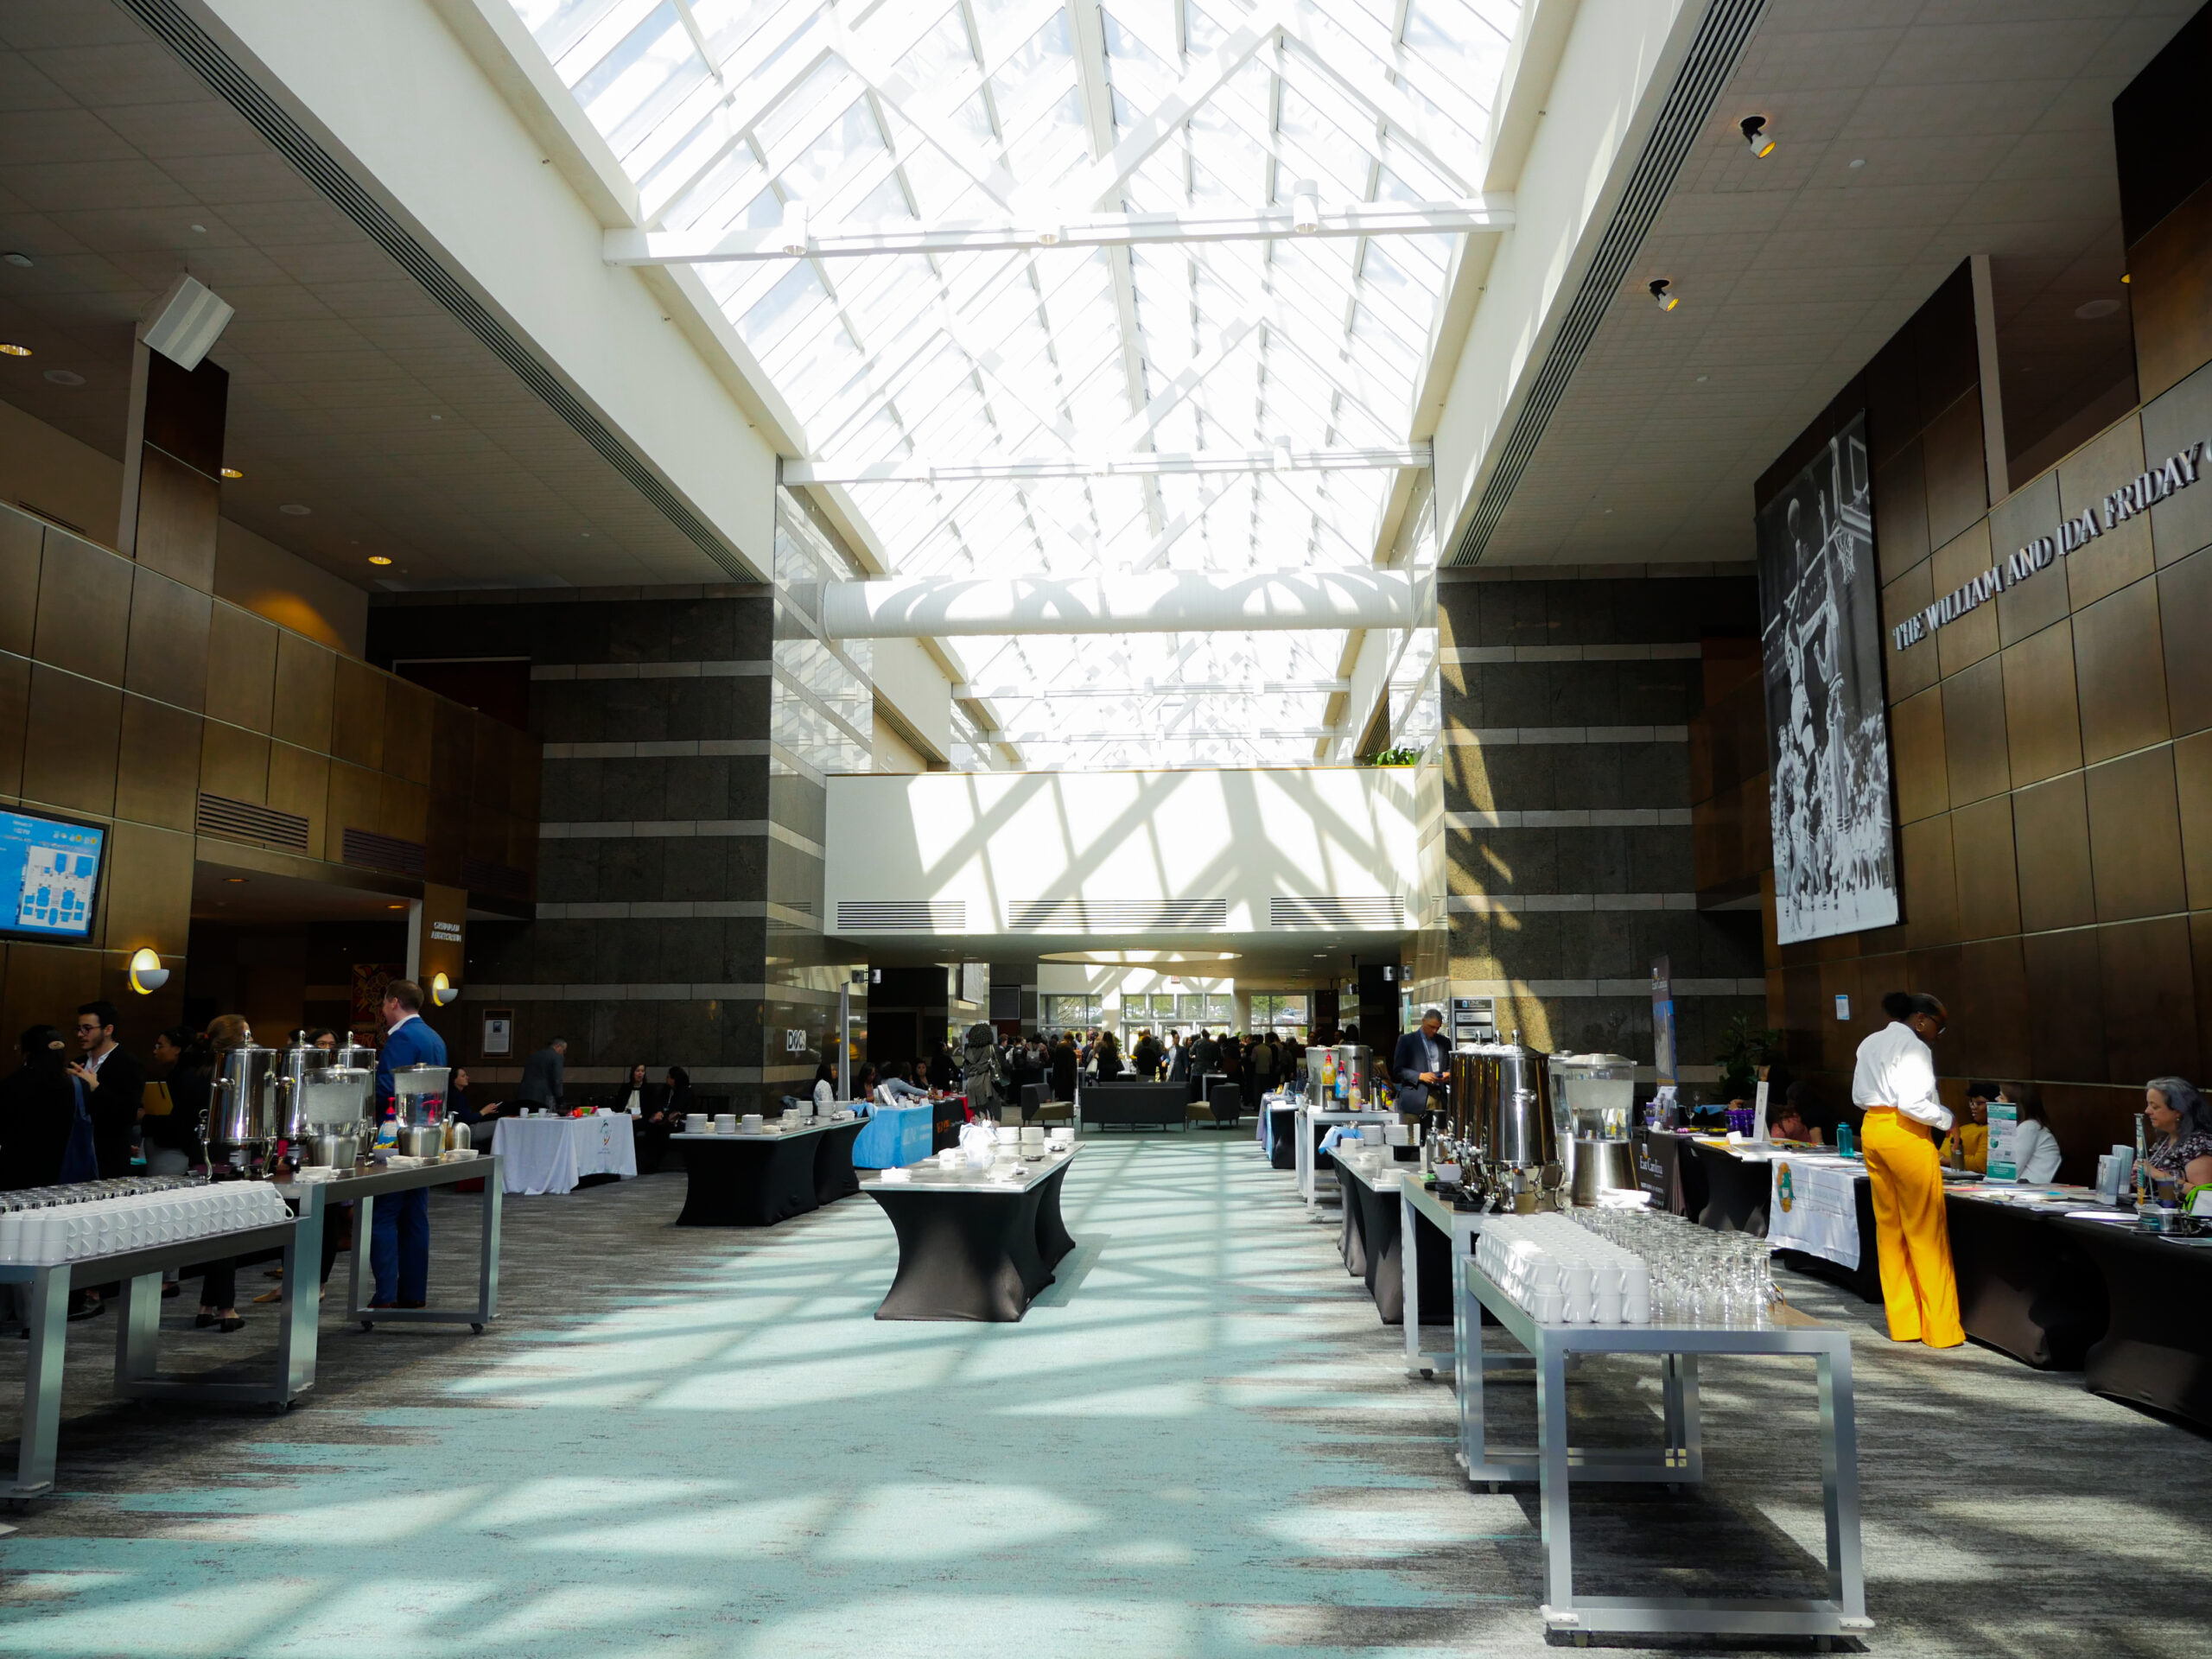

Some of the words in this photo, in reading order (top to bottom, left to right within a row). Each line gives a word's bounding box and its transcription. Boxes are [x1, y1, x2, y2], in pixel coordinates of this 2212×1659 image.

[1892, 612, 1926, 651] THE
[1925, 565, 2005, 632] WILLIAM
[2007, 537, 2054, 586] AND
[2056, 507, 2102, 556] IDA
[2103, 442, 2202, 529] FRIDAY
[1639, 1154, 1648, 1170] East
[1647, 1157, 1663, 1174] Carolina
